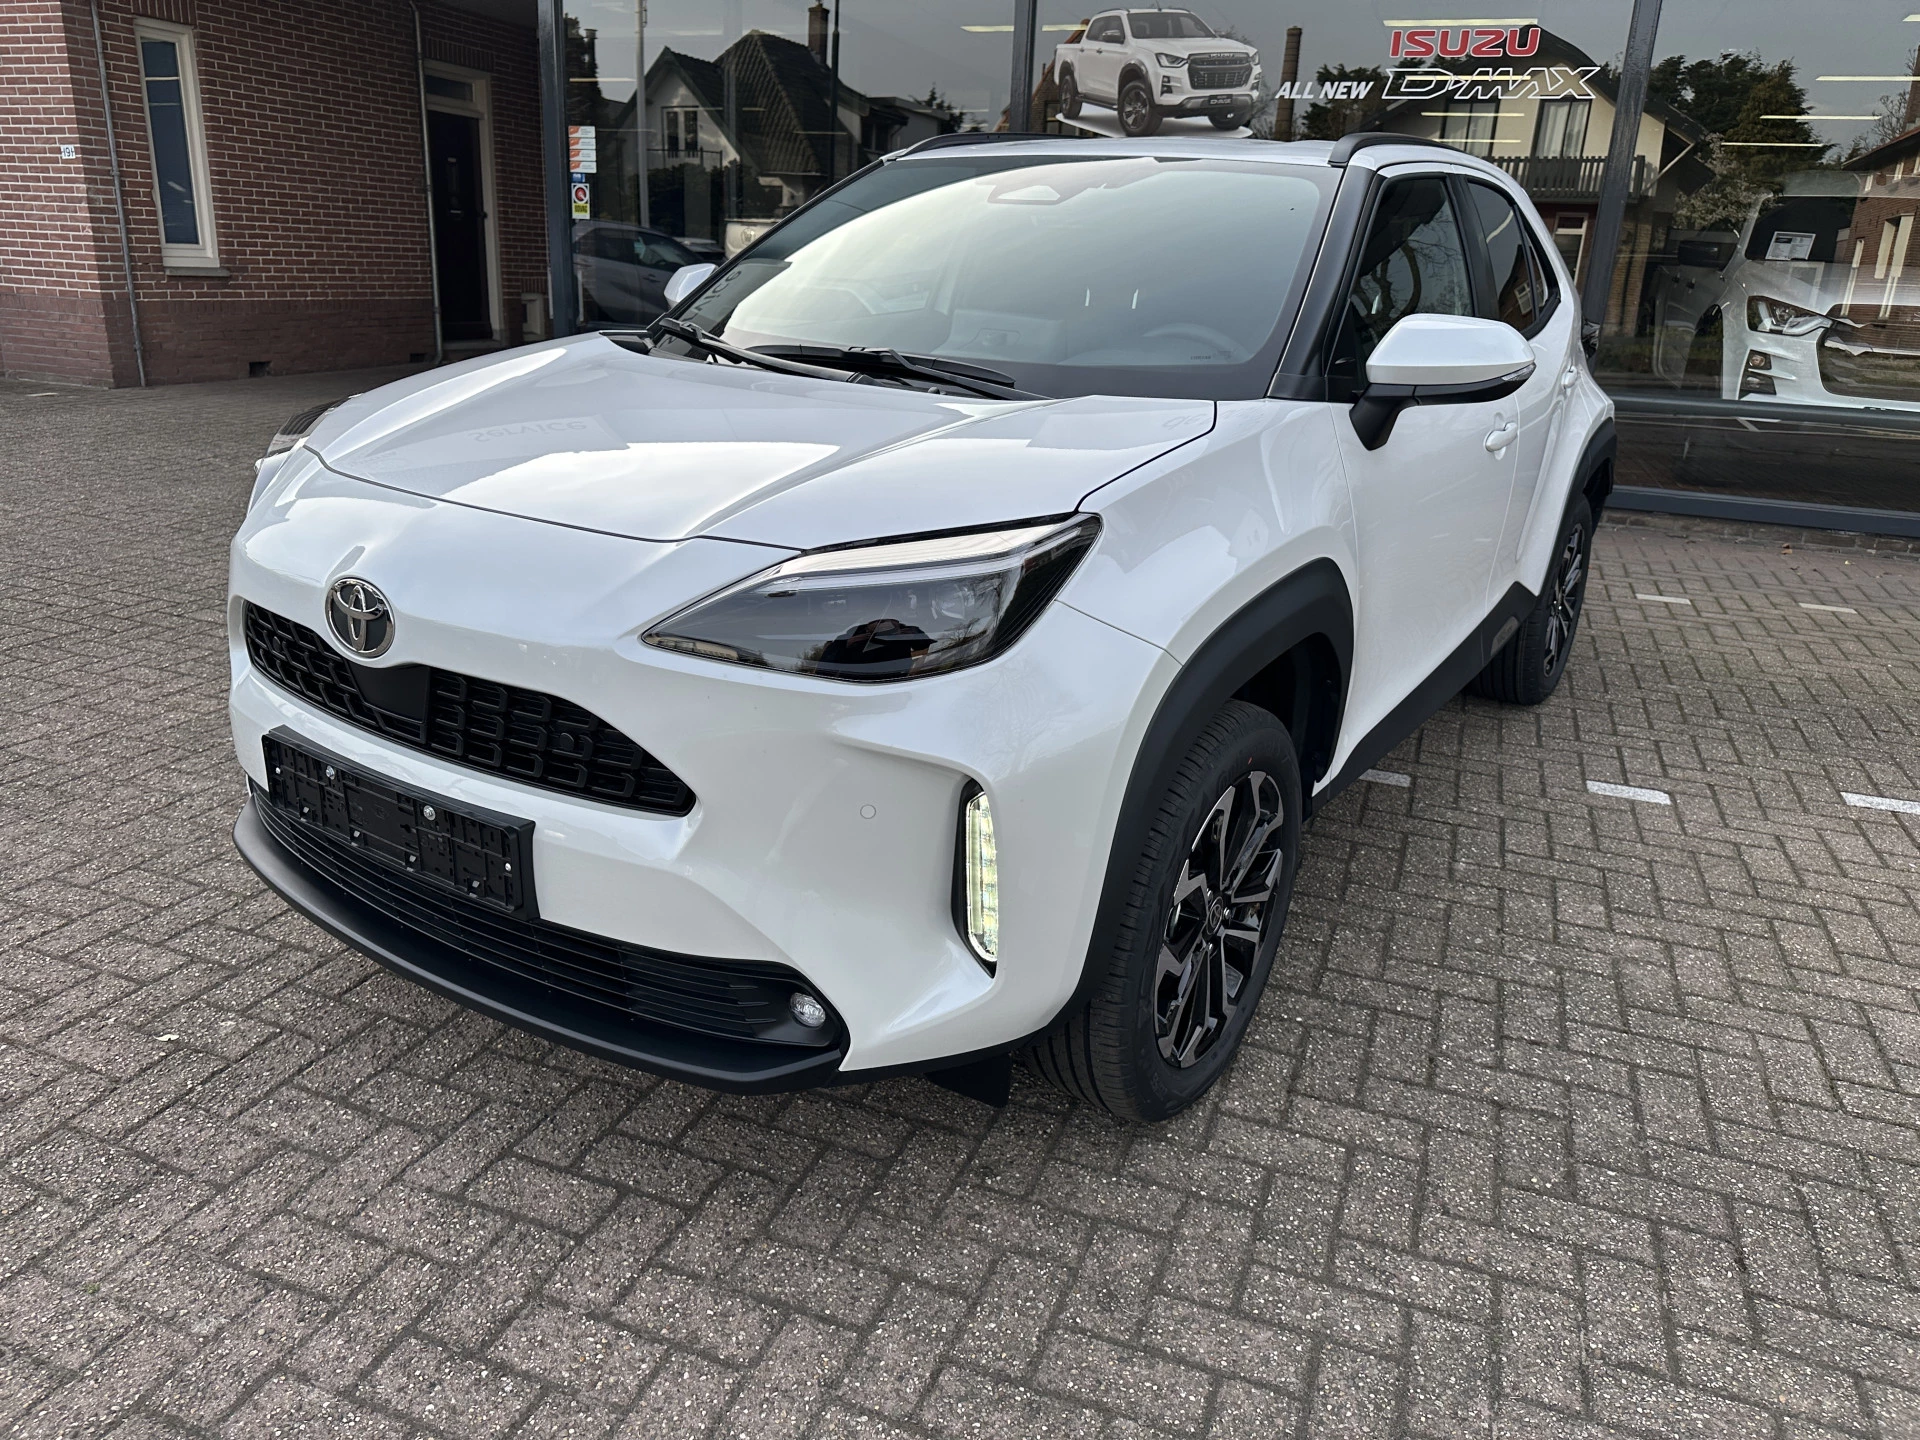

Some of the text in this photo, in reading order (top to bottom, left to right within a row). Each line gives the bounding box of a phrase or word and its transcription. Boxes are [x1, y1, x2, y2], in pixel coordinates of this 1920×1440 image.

[1389, 28, 1541, 57] ISUZU
[1275, 67, 1601, 99] ALL NEW D-MAX
